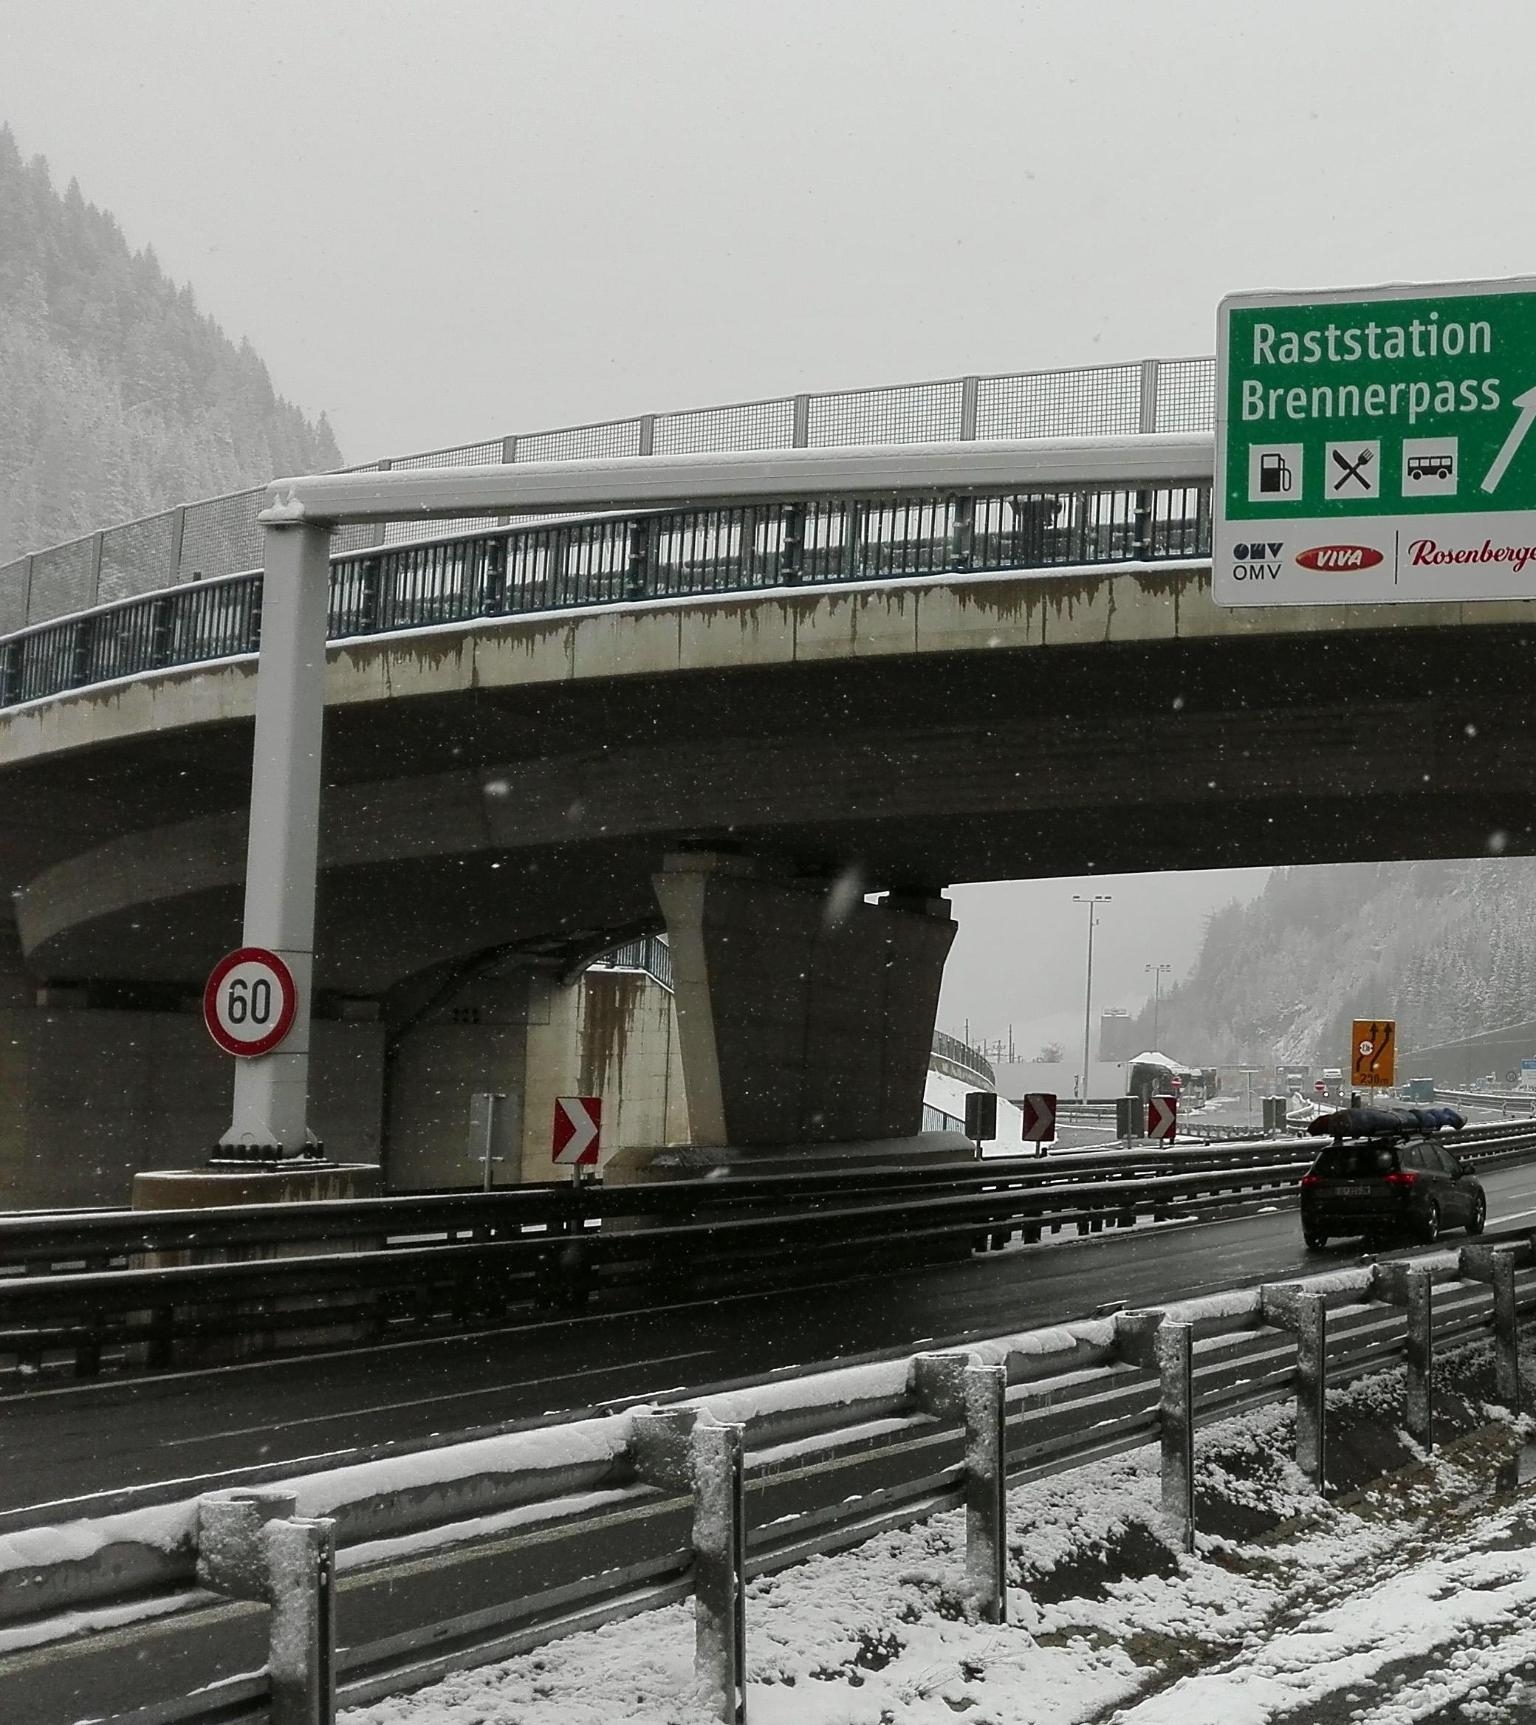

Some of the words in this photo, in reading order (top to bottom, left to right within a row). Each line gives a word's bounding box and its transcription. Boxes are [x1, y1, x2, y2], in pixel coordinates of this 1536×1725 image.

[1253, 312, 1492, 365] Raststation
[1241, 377, 1501, 425] Brennerpass
[1233, 564, 1282, 581] OMV
[1316, 549, 1363, 567] VIVA
[228, 978, 272, 1025] 60
